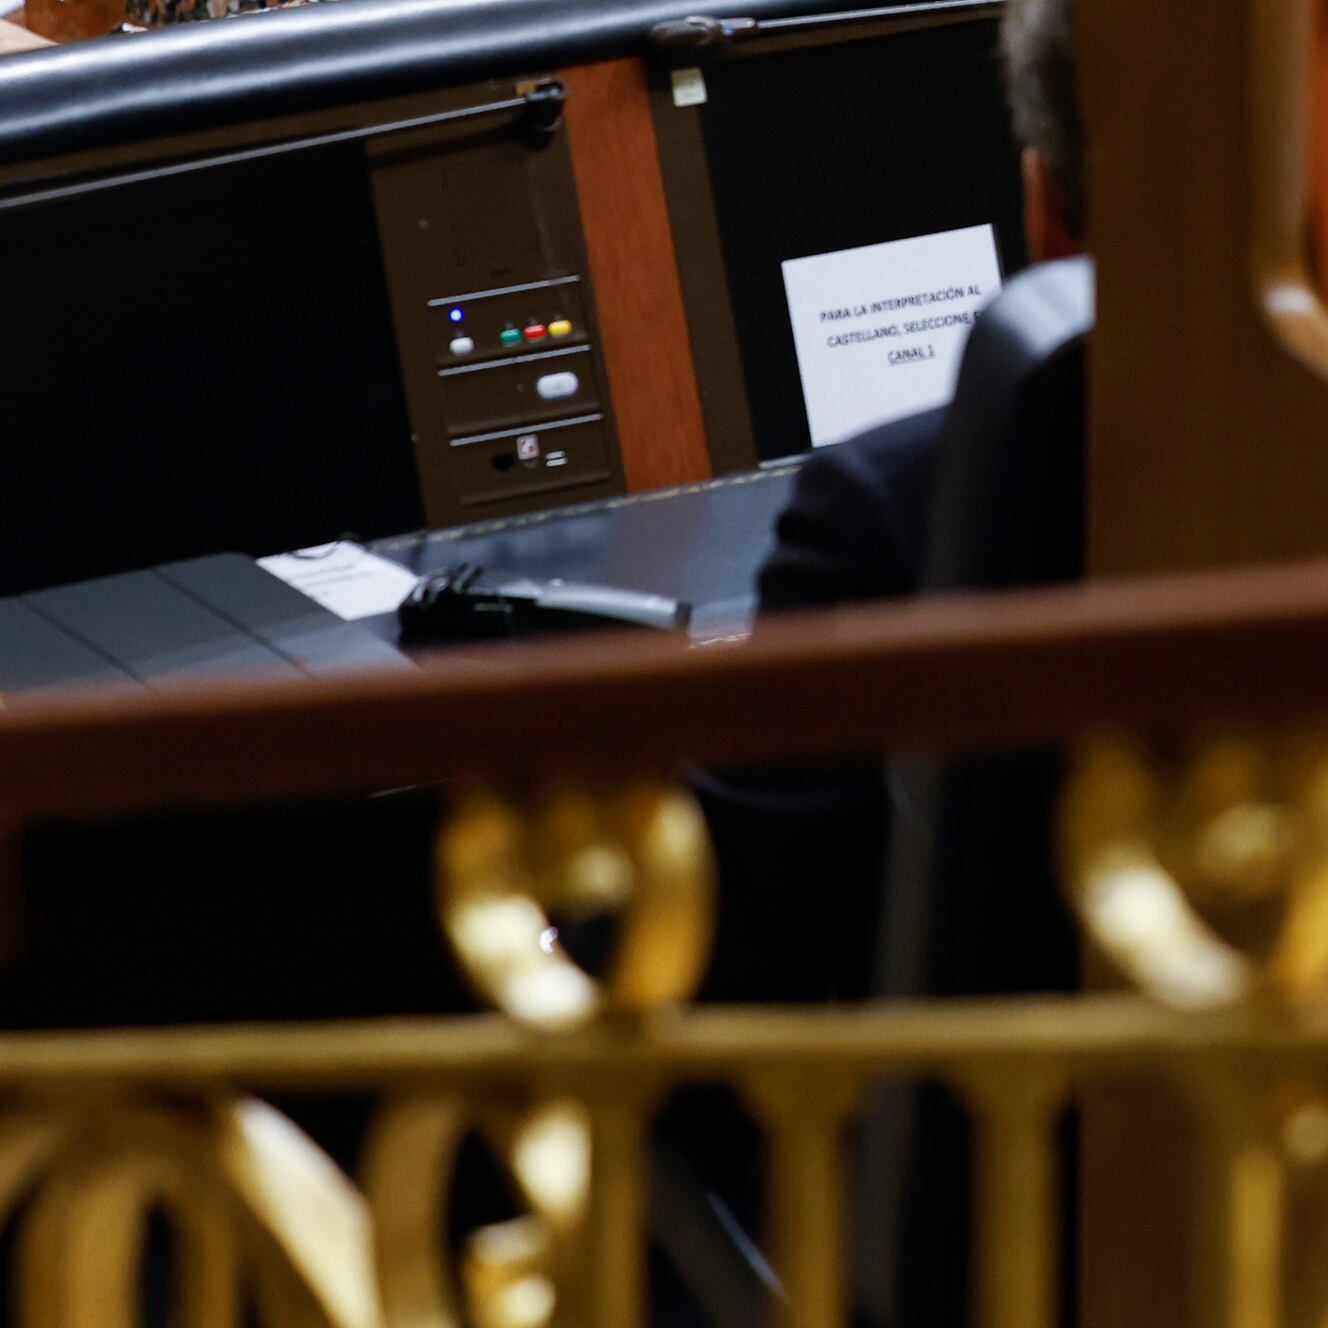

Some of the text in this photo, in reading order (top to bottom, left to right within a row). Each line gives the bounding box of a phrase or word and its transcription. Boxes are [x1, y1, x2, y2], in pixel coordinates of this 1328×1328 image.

[819, 285, 981, 324] PARA LA INTERPRETACIÓN AL
[903, 312, 972, 333] SELECCIONE
[887, 347, 926, 366] CANAL
